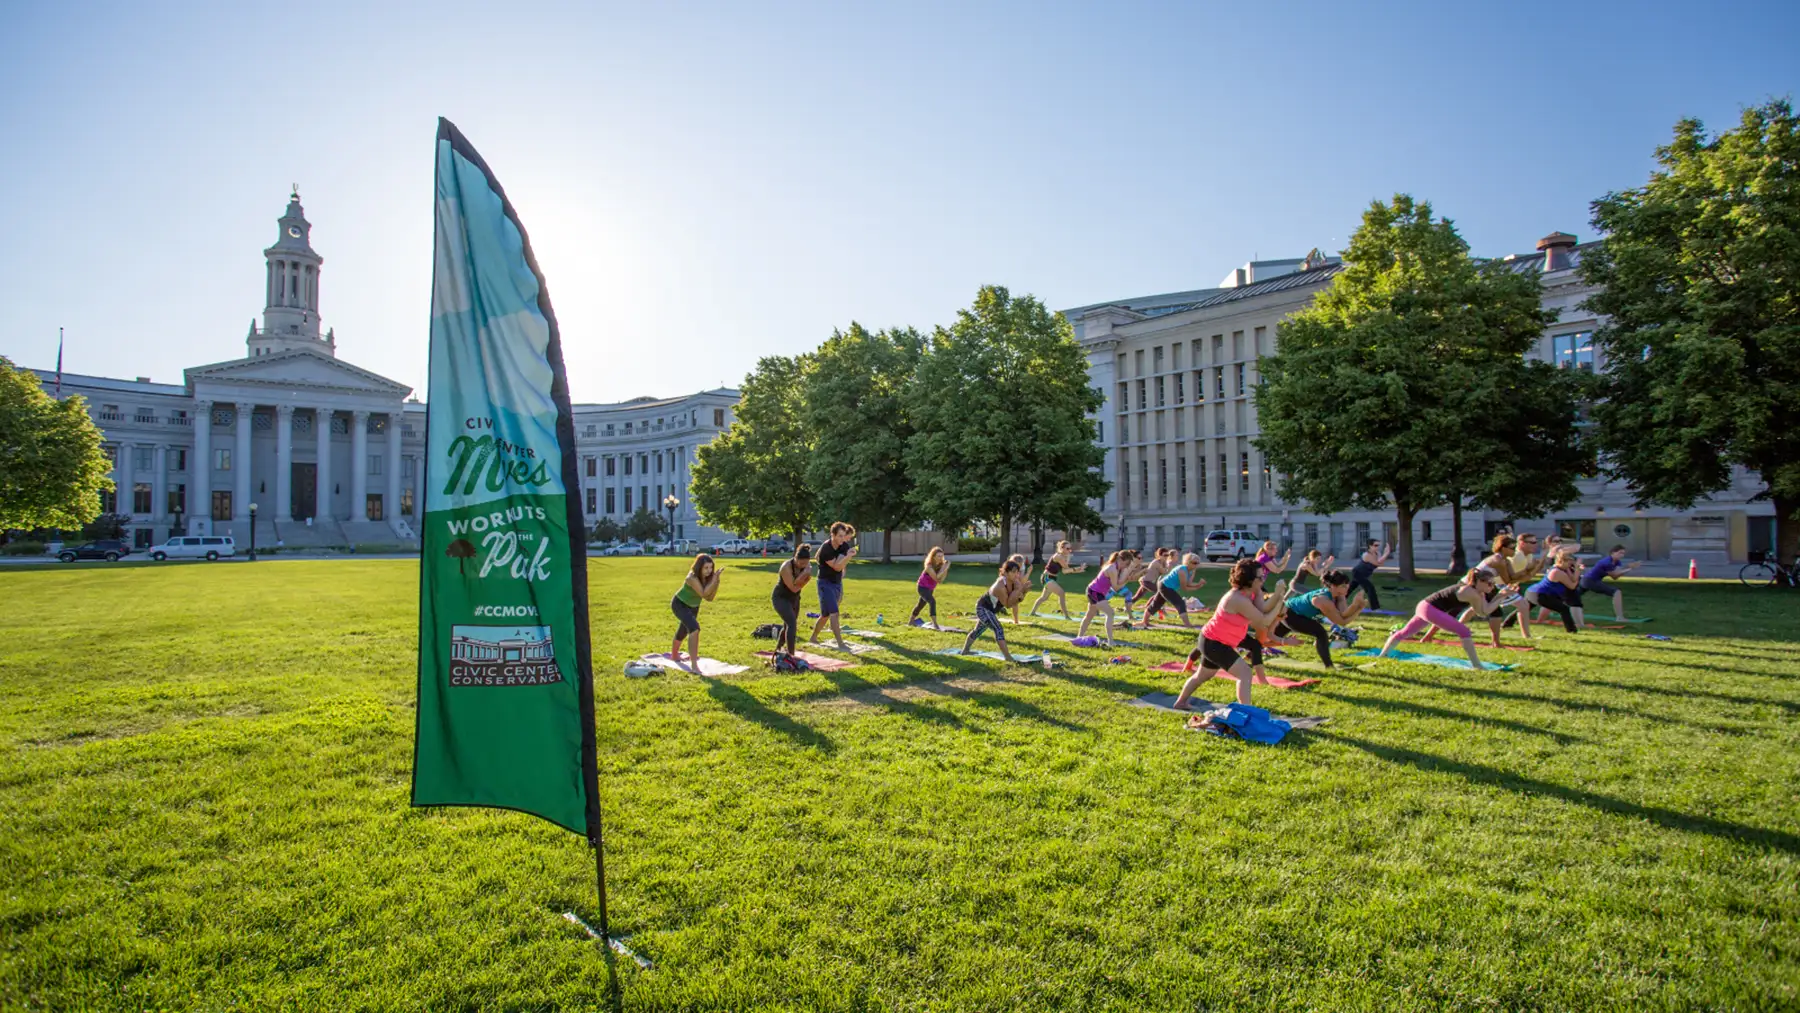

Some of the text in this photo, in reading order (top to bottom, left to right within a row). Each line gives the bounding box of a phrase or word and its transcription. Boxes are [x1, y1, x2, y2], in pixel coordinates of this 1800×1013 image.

[517, 533, 534, 541] THE
[479, 531, 551, 582] Pak
[452, 666, 498, 677] CIVIC
[451, 674, 563, 685] CONSERVANCY
